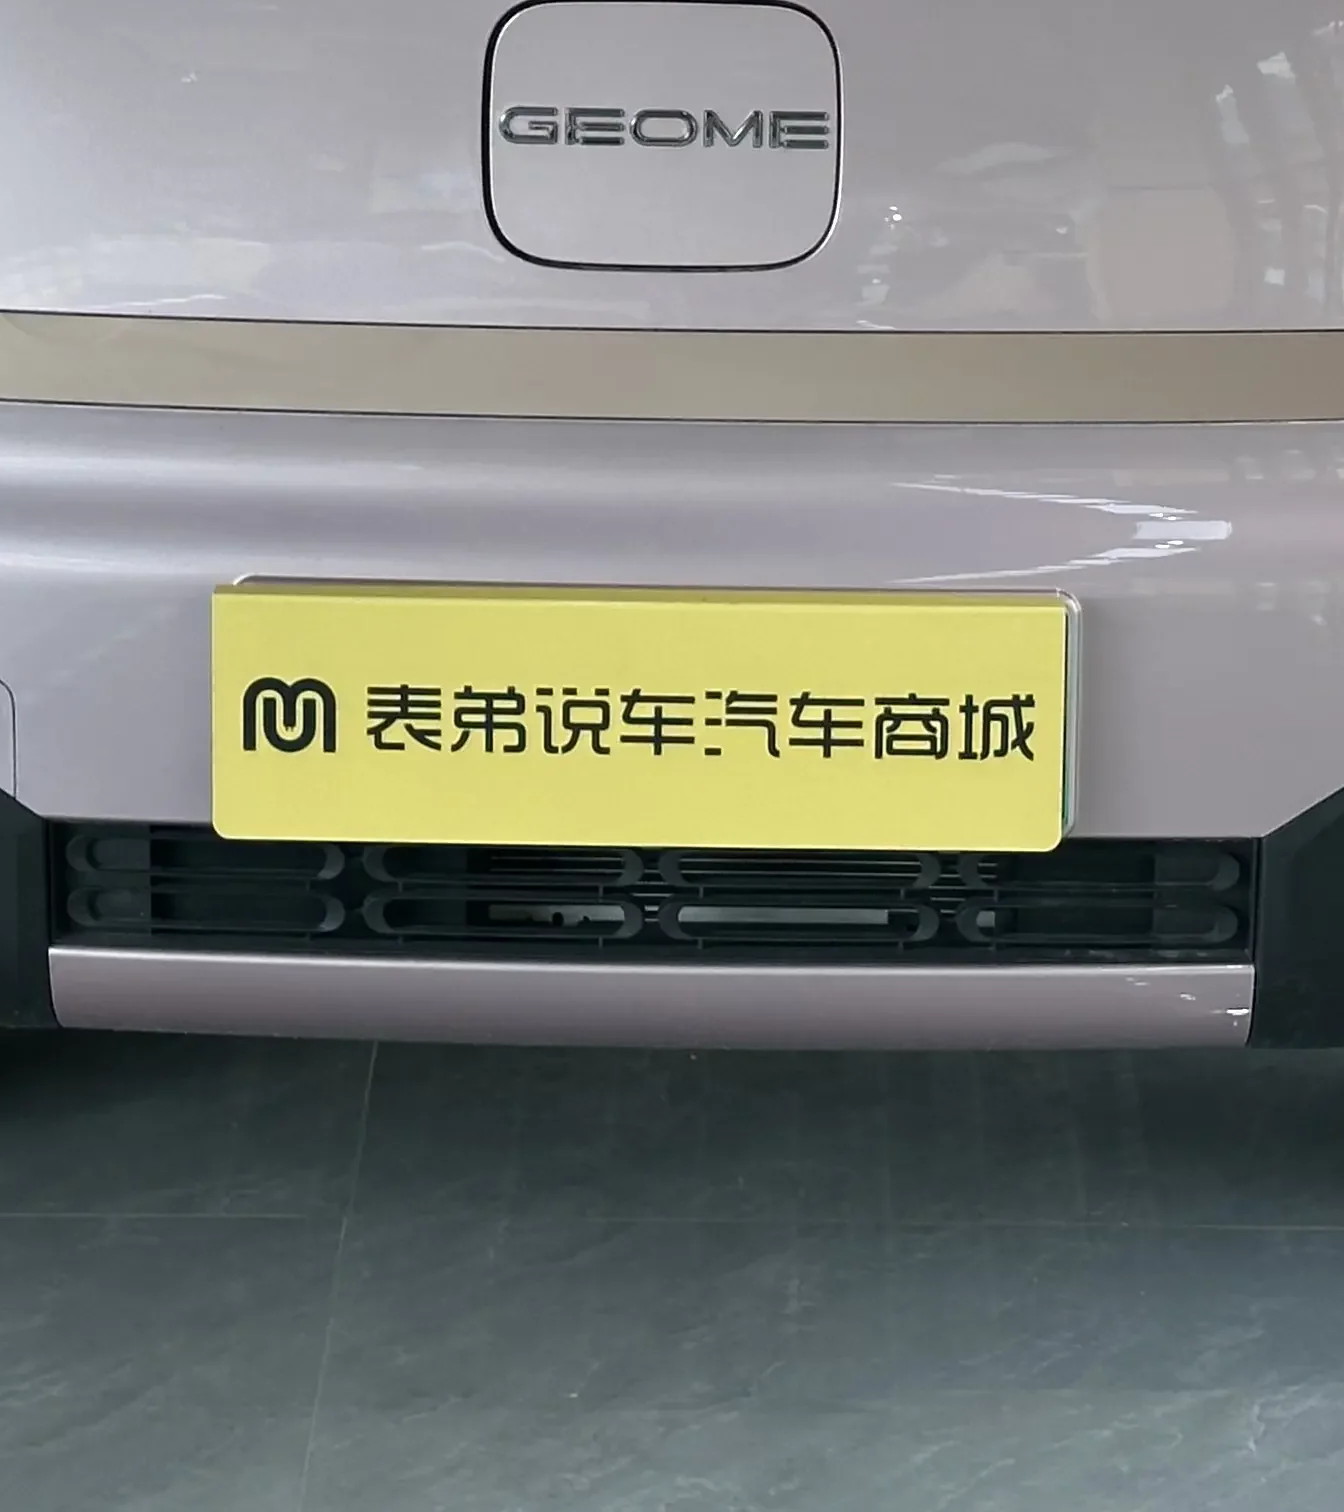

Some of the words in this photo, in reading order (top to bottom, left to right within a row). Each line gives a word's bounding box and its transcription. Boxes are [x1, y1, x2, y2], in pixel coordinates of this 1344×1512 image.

[498, 105, 831, 150] GEOME
[366, 682, 1036, 762] 表弟说车汽车商城
